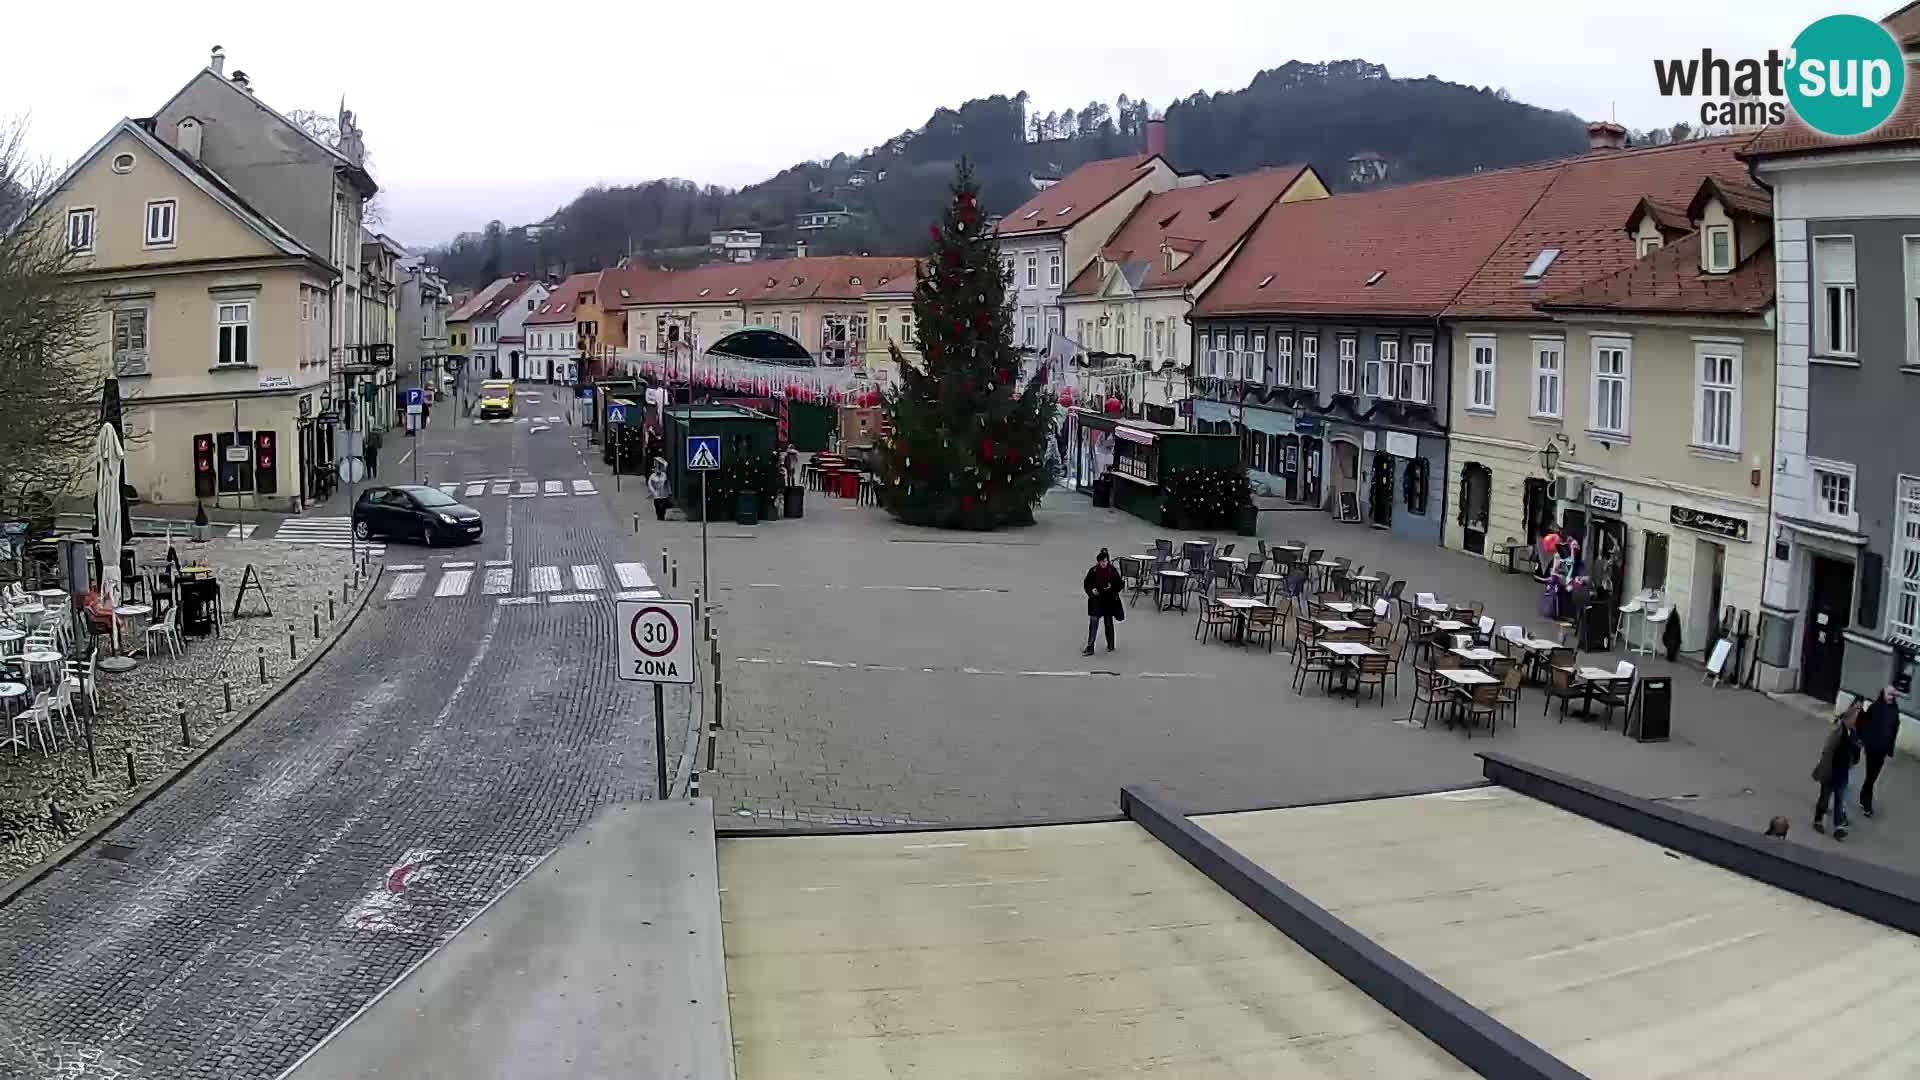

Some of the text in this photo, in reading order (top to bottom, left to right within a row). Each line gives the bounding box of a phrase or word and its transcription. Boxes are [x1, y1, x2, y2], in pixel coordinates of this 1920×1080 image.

[411, 391, 418, 402] P
[643, 622, 667, 643] 30
[634, 659, 678, 676] ZONA
